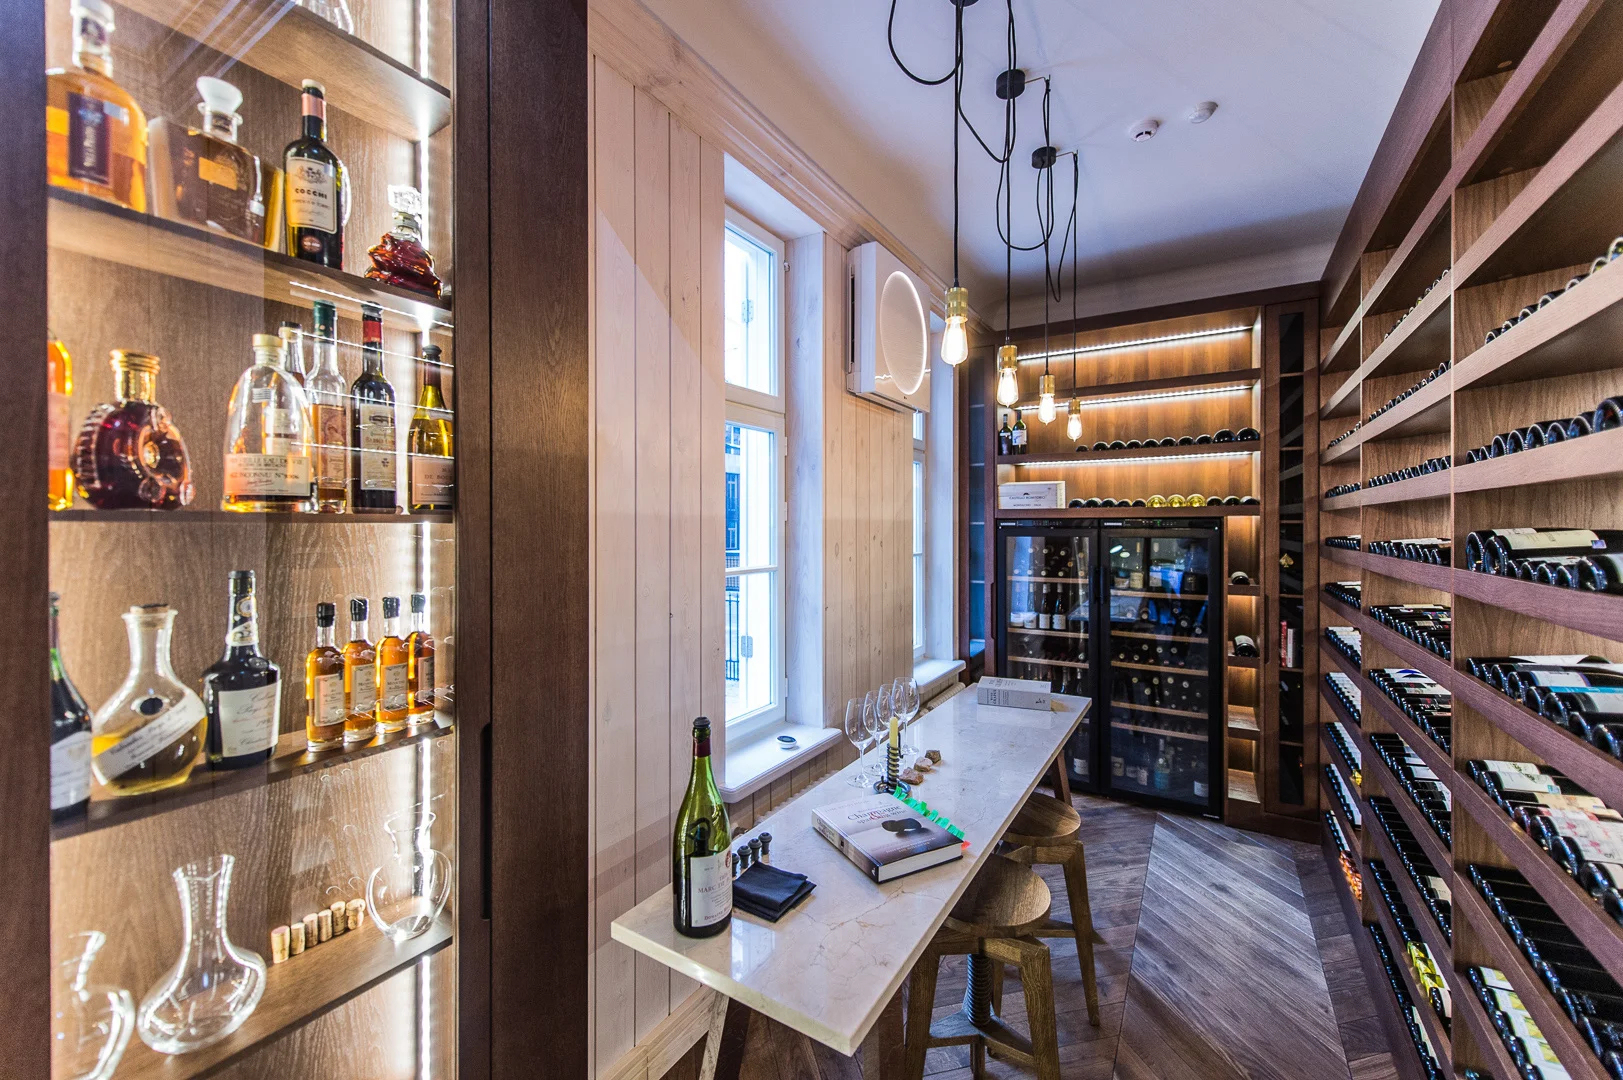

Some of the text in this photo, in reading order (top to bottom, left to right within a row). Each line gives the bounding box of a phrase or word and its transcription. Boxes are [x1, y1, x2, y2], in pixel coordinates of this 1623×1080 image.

[295, 188, 328, 199] COCCHI
[847, 806, 902, 821] Champagne
[698, 885, 717, 893] MARC
